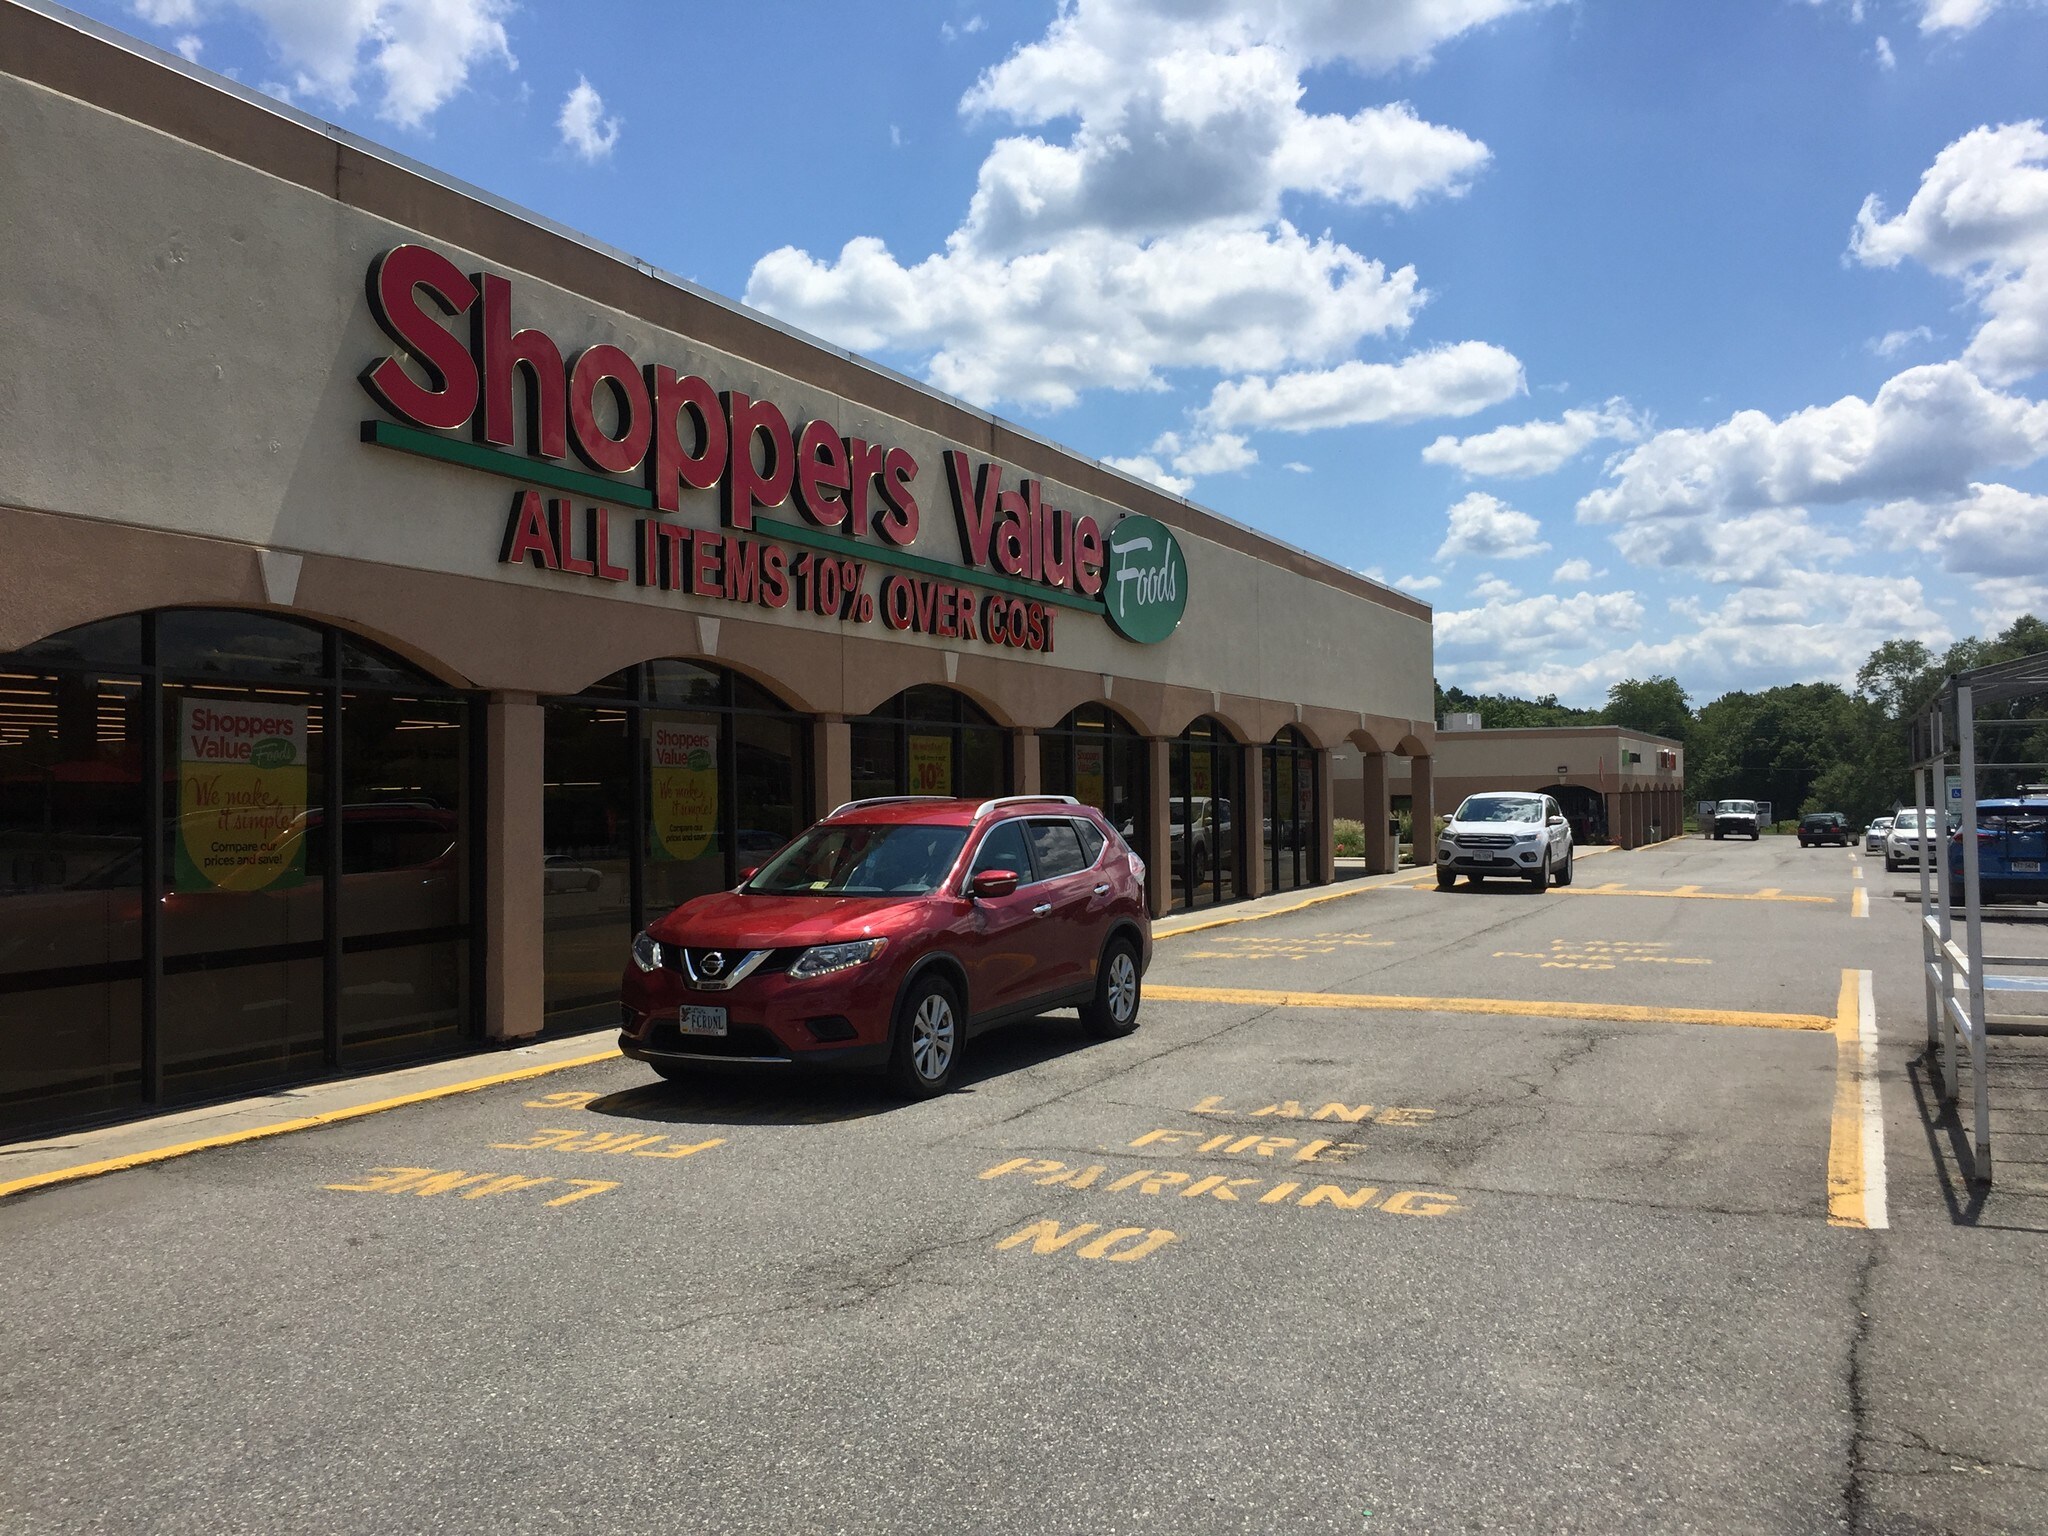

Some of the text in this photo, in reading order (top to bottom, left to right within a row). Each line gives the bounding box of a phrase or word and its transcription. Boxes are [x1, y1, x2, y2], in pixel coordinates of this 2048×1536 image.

[359, 243, 1104, 596] Shoppers Value
[499, 489, 1057, 653] ALL ITEMS 10% OVER COST
[1112, 536, 1177, 618] Foods
[191, 708, 294, 738] Shoppers
[656, 729, 710, 749] Shoppers
[190, 736, 252, 760] Value
[656, 748, 688, 765] Value
[185, 774, 279, 809] We make
[217, 806, 232, 832] it
[204, 854, 283, 870] prices and save!
[211, 841, 278, 854] Compare our
[1190, 1095, 1437, 1127] LANE
[486, 1129, 728, 1159] FIRE
[1128, 1128, 1370, 1163] FIRE
[320, 1167, 623, 1207] LANE
[978, 1157, 1463, 1217] PARKING
[994, 1218, 1181, 1262] NO
